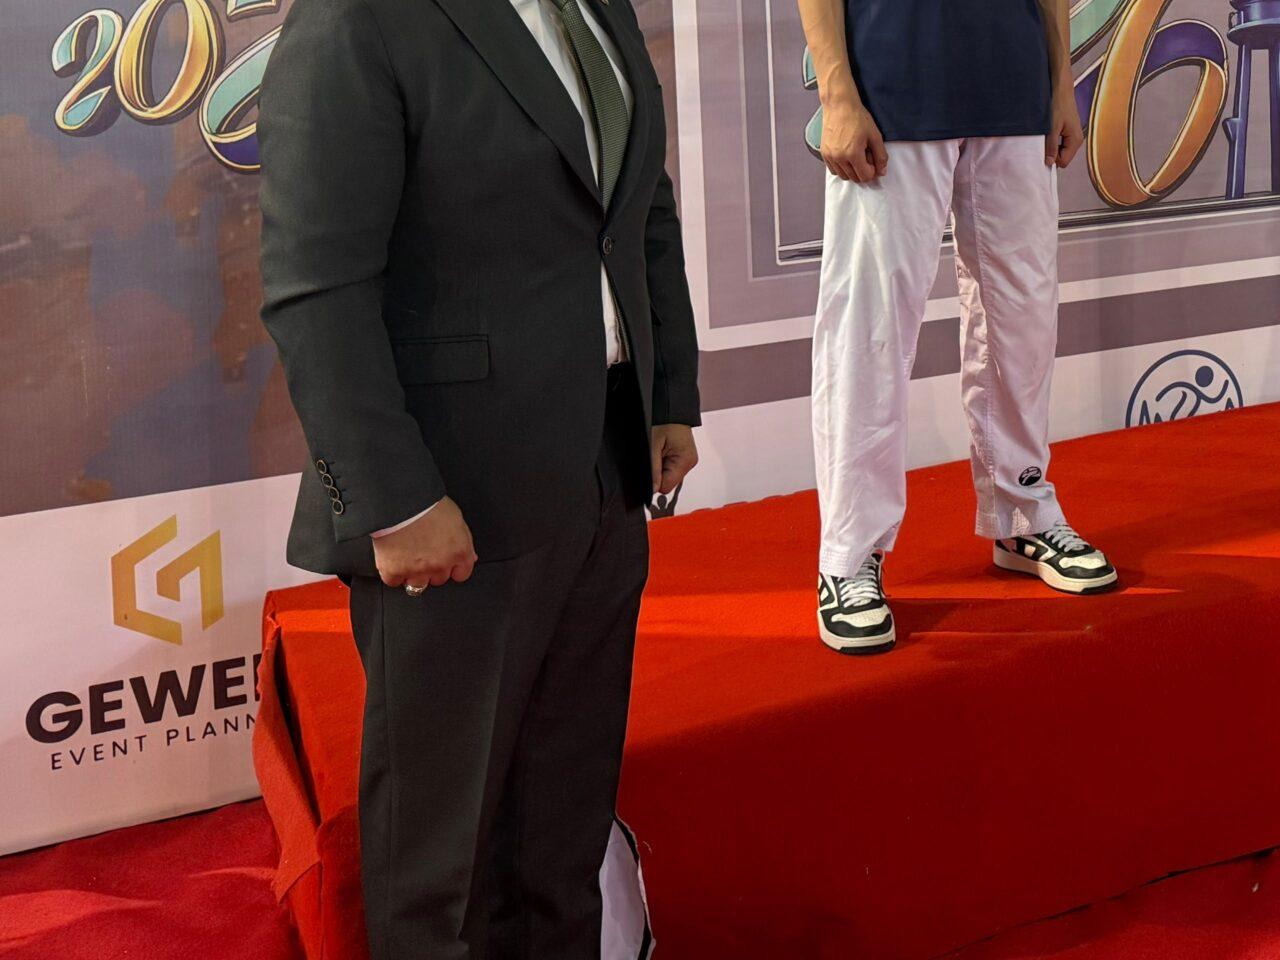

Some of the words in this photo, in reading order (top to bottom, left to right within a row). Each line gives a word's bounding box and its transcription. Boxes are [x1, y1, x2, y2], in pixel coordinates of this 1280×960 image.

[25, 653, 262, 744] GEWE
[51, 735, 148, 771] EVENT
[166, 713, 257, 747] PLANN
